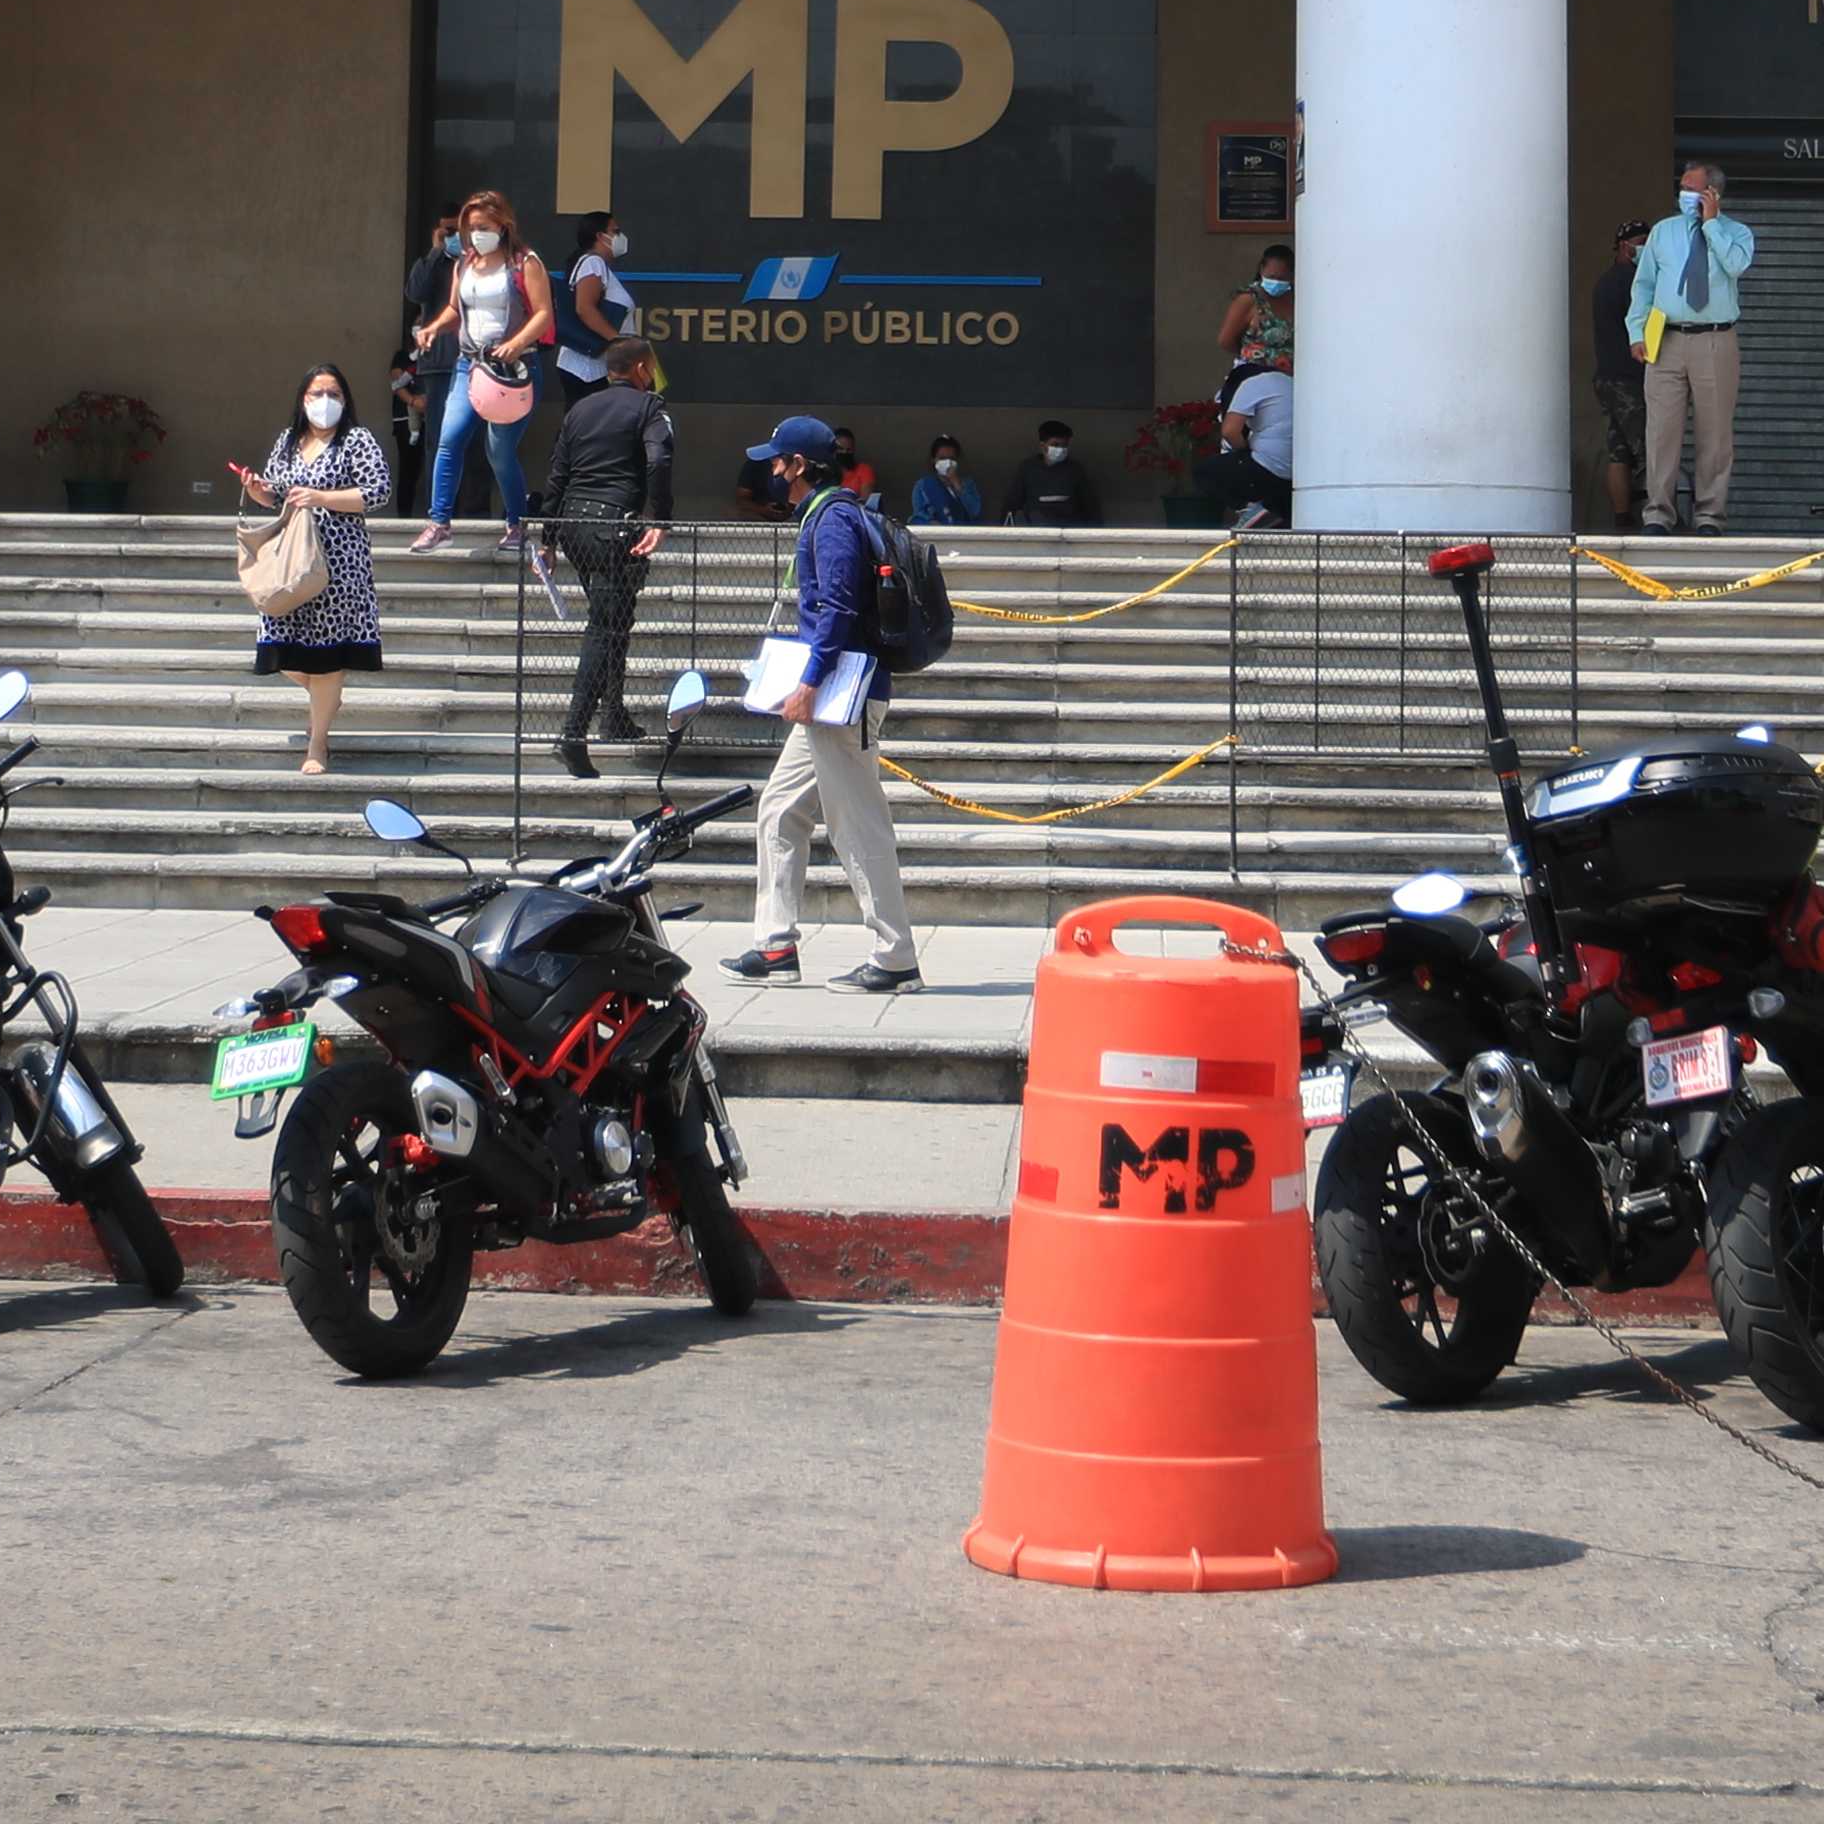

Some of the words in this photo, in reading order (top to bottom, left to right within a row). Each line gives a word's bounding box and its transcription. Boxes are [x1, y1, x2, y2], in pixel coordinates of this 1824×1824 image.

[1243, 156, 1263, 166] MP
[634, 307, 808, 344] ISTERIO
[823, 301, 1020, 346] PÚBLICO
[1553, 768, 1605, 790] SUZUKI
[223, 1042, 305, 1080] M363GWV
[1301, 1081, 1345, 1110] 5GCG
[1099, 1123, 1256, 1214] MP
